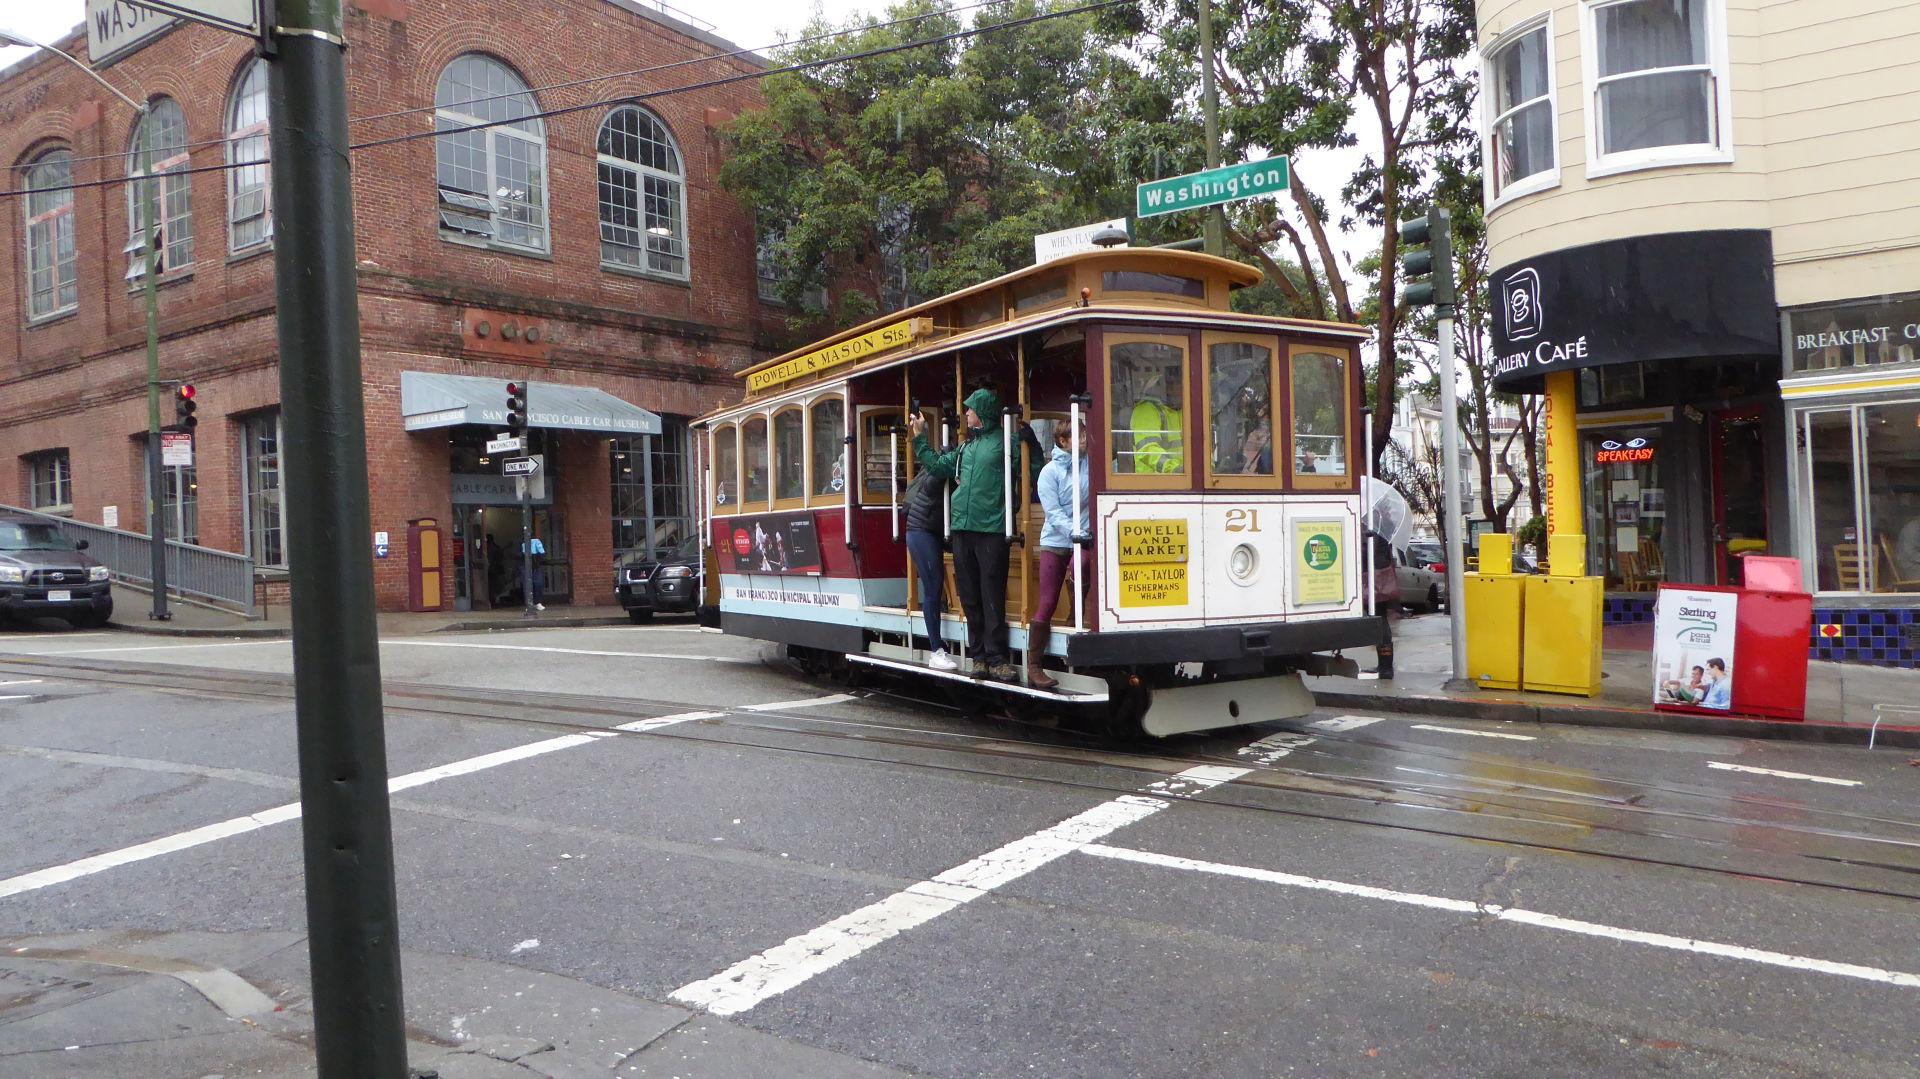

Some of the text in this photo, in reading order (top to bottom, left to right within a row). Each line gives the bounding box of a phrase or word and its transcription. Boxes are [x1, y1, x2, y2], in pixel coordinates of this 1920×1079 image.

[1146, 167, 1280, 207] Washington
[1051, 231, 1096, 248] WHEN FLAS
[1797, 326, 1890, 350] BREAKFAST
[754, 328, 907, 387] POWELL & MASON Sts.
[482, 409, 503, 420] SAN
[561, 414, 591, 426] CABLE
[593, 416, 611, 428] CAR
[613, 418, 650, 430] MUSEUM
[1597, 448, 1653, 462] SPEAKEASY
[506, 463, 517, 471] ONE
[1546, 473, 1555, 552] BEER
[1225, 508, 1262, 533] 21
[1123, 525, 1185, 536] POWELL
[1140, 536, 1171, 545] AND
[1123, 545, 1186, 556] MARKET
[1123, 570, 1139, 581] BAY
[1151, 568, 1185, 581] TAYLOR
[1128, 582, 1180, 592] FISHERMANS
[736, 588, 840, 607] SAN FRANCISCO MUNICIPAL RAILWAY
[1140, 592, 1168, 600] WHARF
[1679, 606, 1717, 619] Sterling
[1690, 631, 1711, 639] bank
